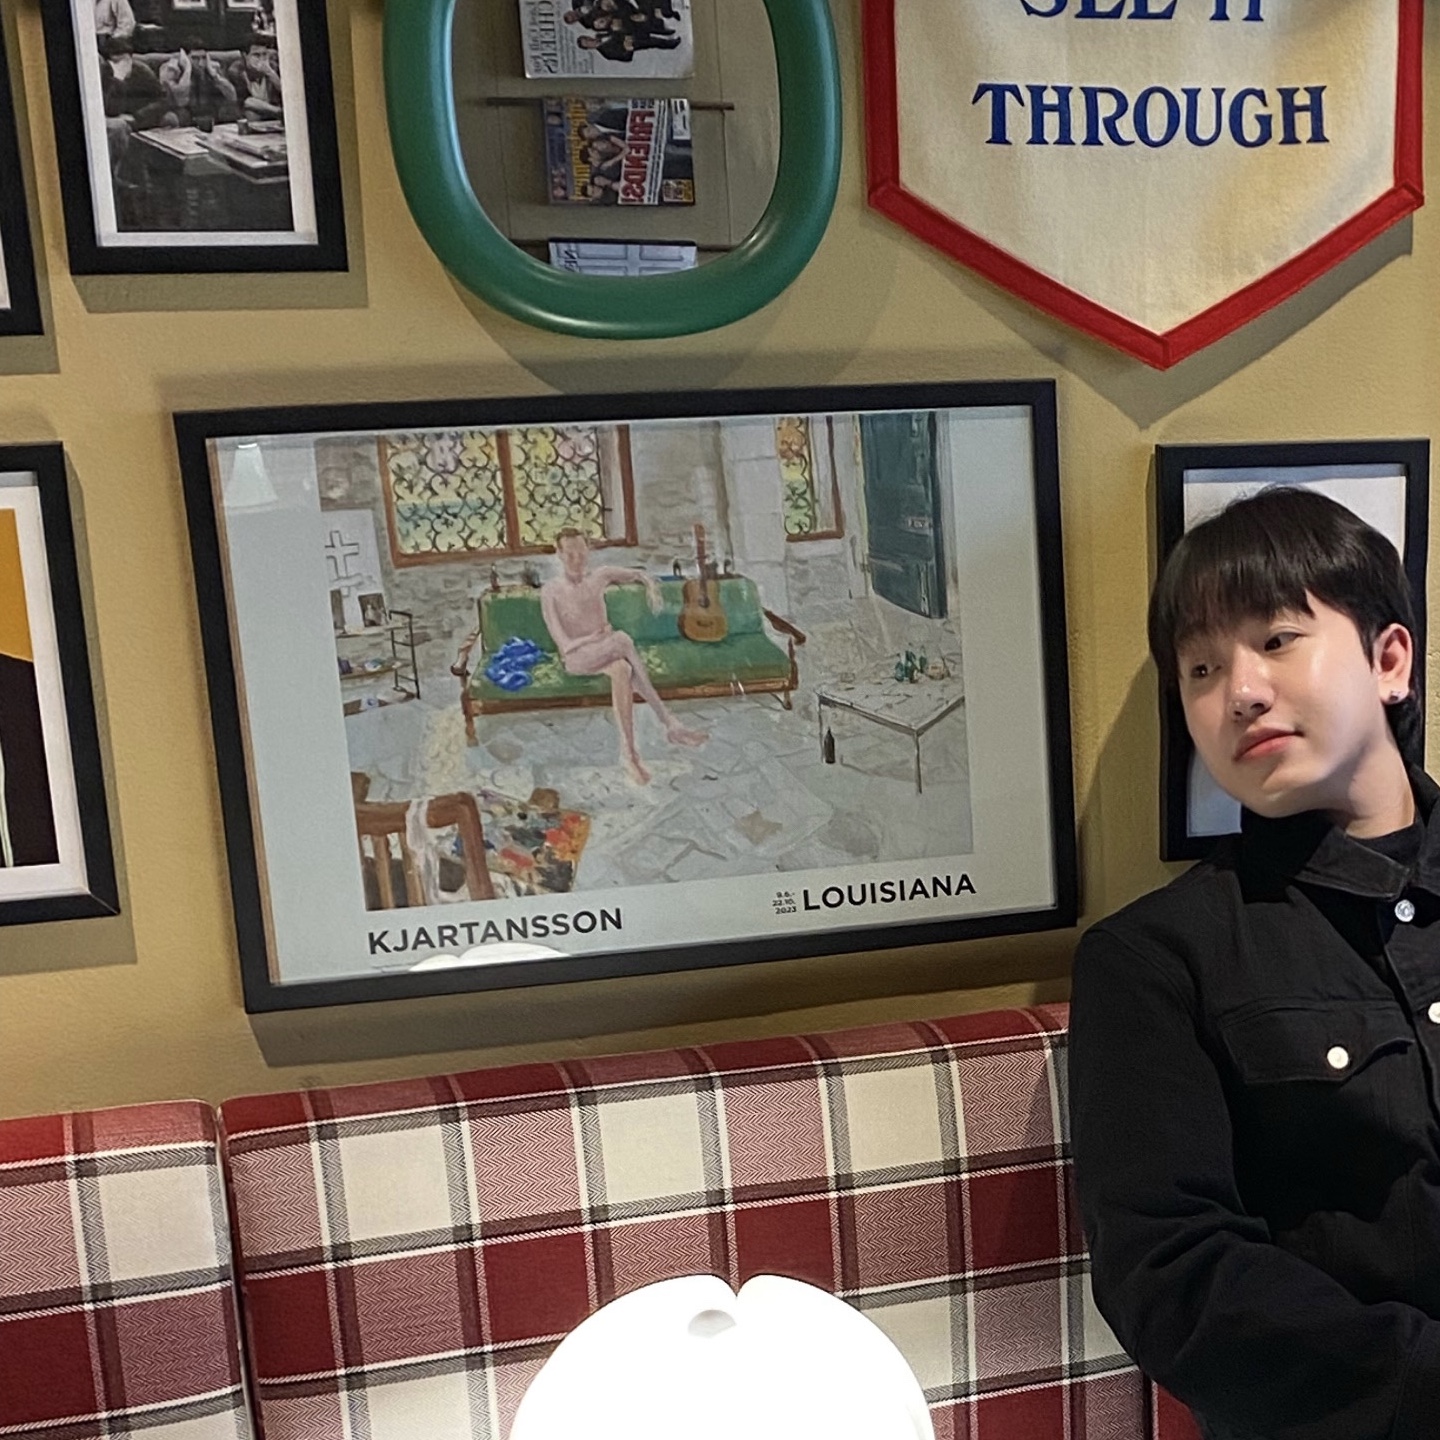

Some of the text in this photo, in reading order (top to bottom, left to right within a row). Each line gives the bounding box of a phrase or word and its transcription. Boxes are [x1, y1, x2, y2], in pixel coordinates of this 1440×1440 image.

[972, 82, 1330, 148] THROUGH
[775, 906, 797, 915] 2023
[803, 873, 977, 911] LOUISIANA
[368, 907, 623, 955] KJARTANSSON
